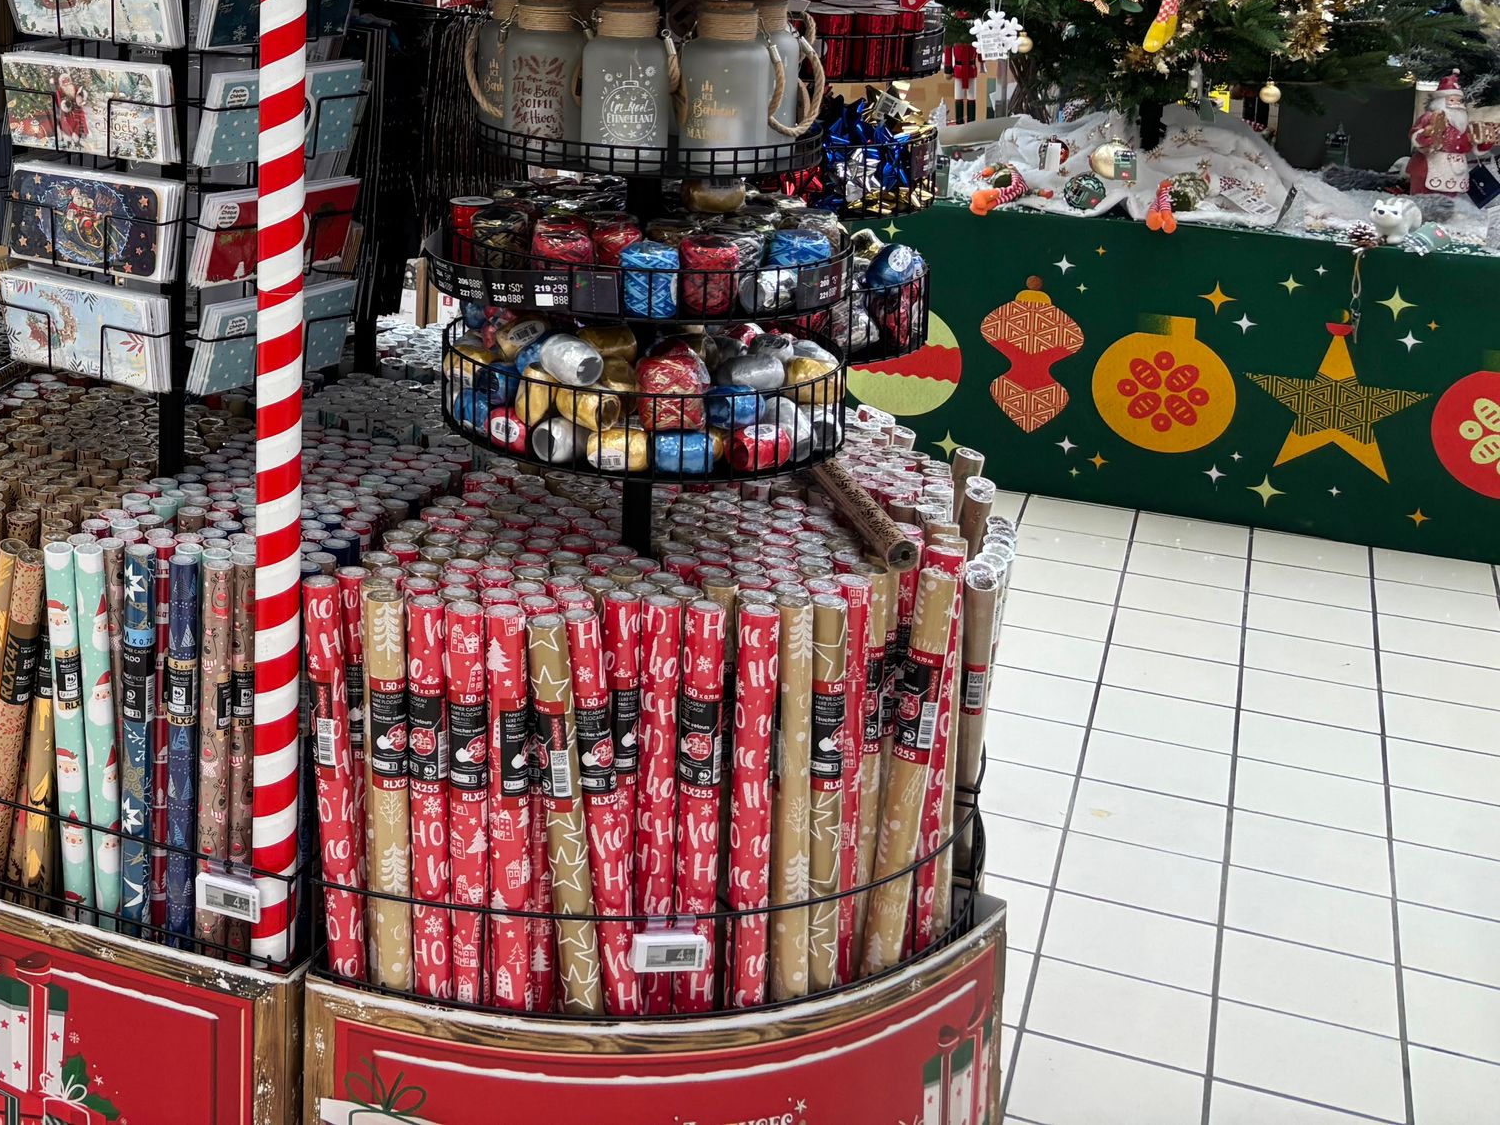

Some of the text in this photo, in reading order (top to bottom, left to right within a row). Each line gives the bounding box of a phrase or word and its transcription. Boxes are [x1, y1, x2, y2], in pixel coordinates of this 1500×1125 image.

[491, 282, 506, 291] 217
[534, 284, 551, 293] 219
[0, 637, 20, 701] RLX247
[460, 694, 477, 704] 1,50
[581, 697, 598, 708] 1,50
